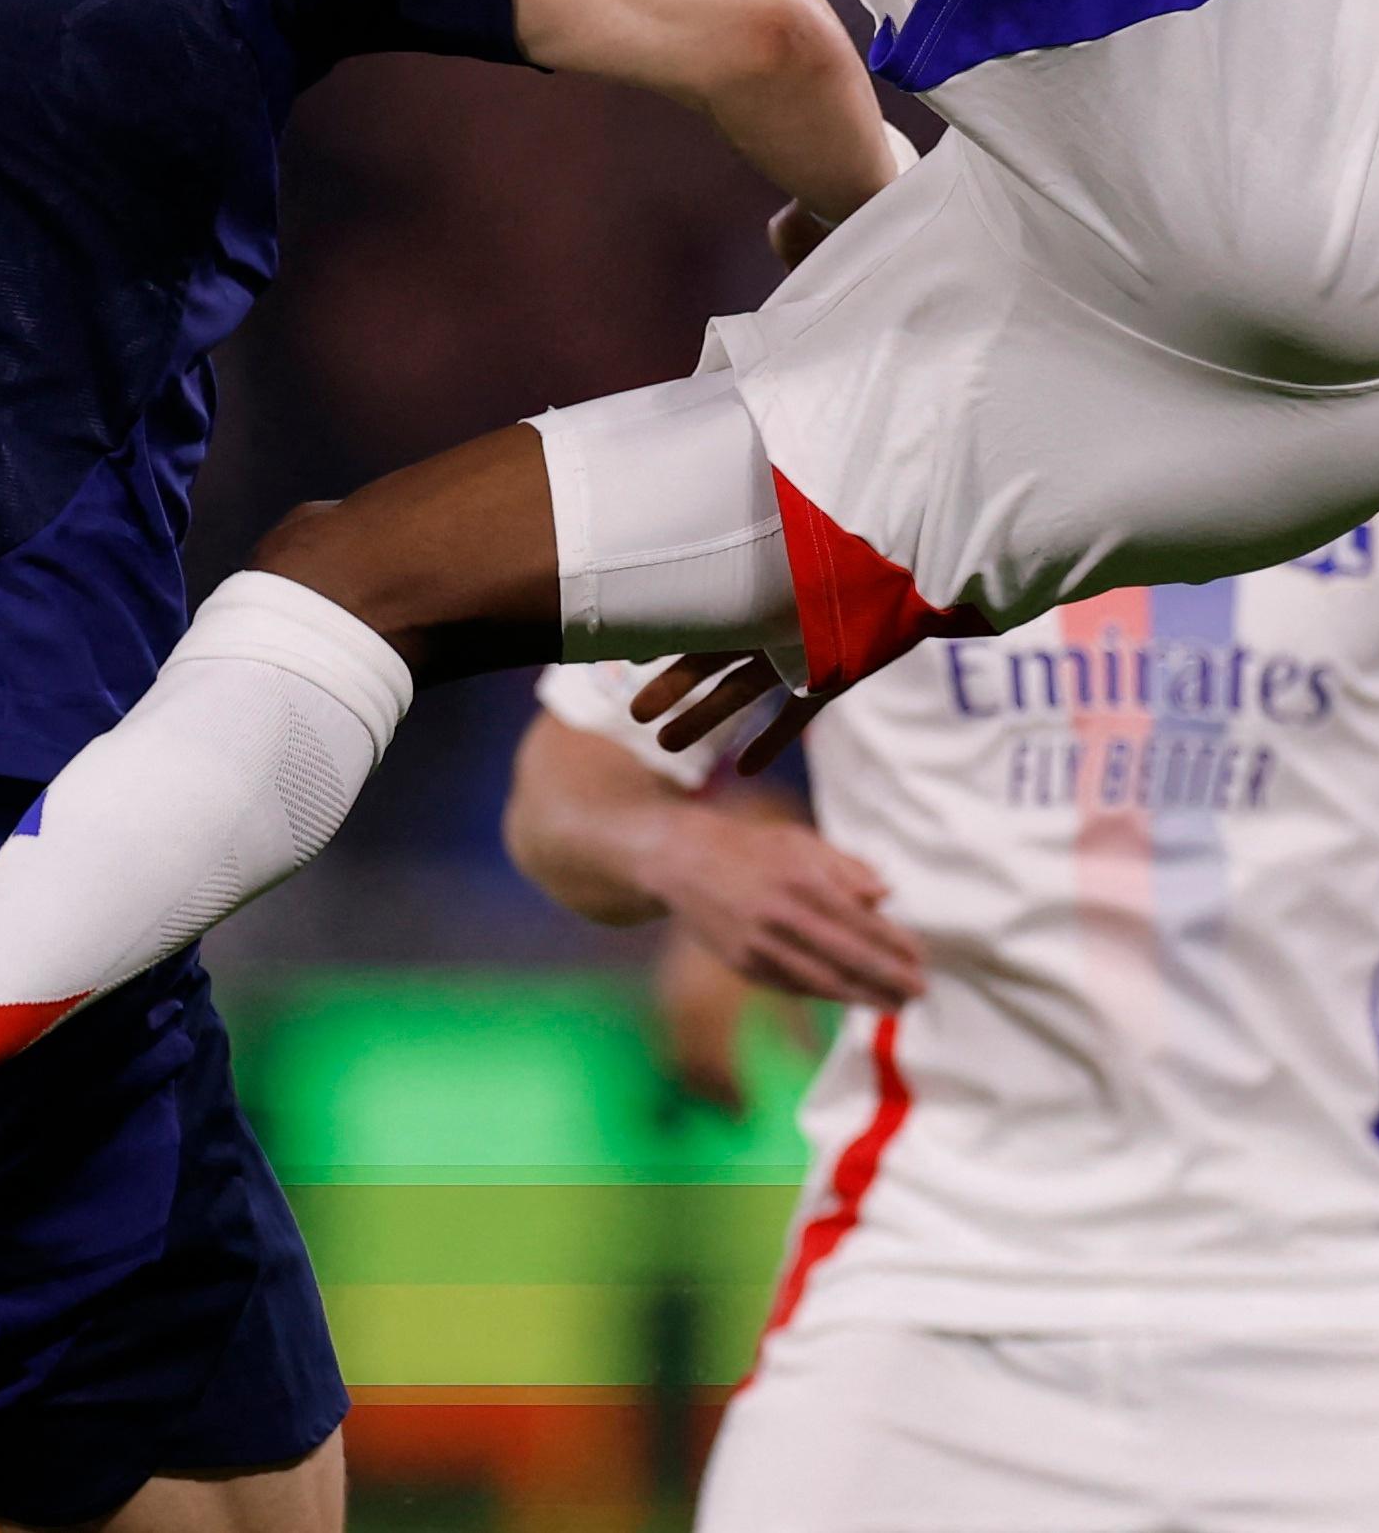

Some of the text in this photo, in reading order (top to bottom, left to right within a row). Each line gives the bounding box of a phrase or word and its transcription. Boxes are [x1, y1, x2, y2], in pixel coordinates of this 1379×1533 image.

[945, 623, 1335, 726] Emirates
[1007, 737, 1278, 809] FLY BETTER
